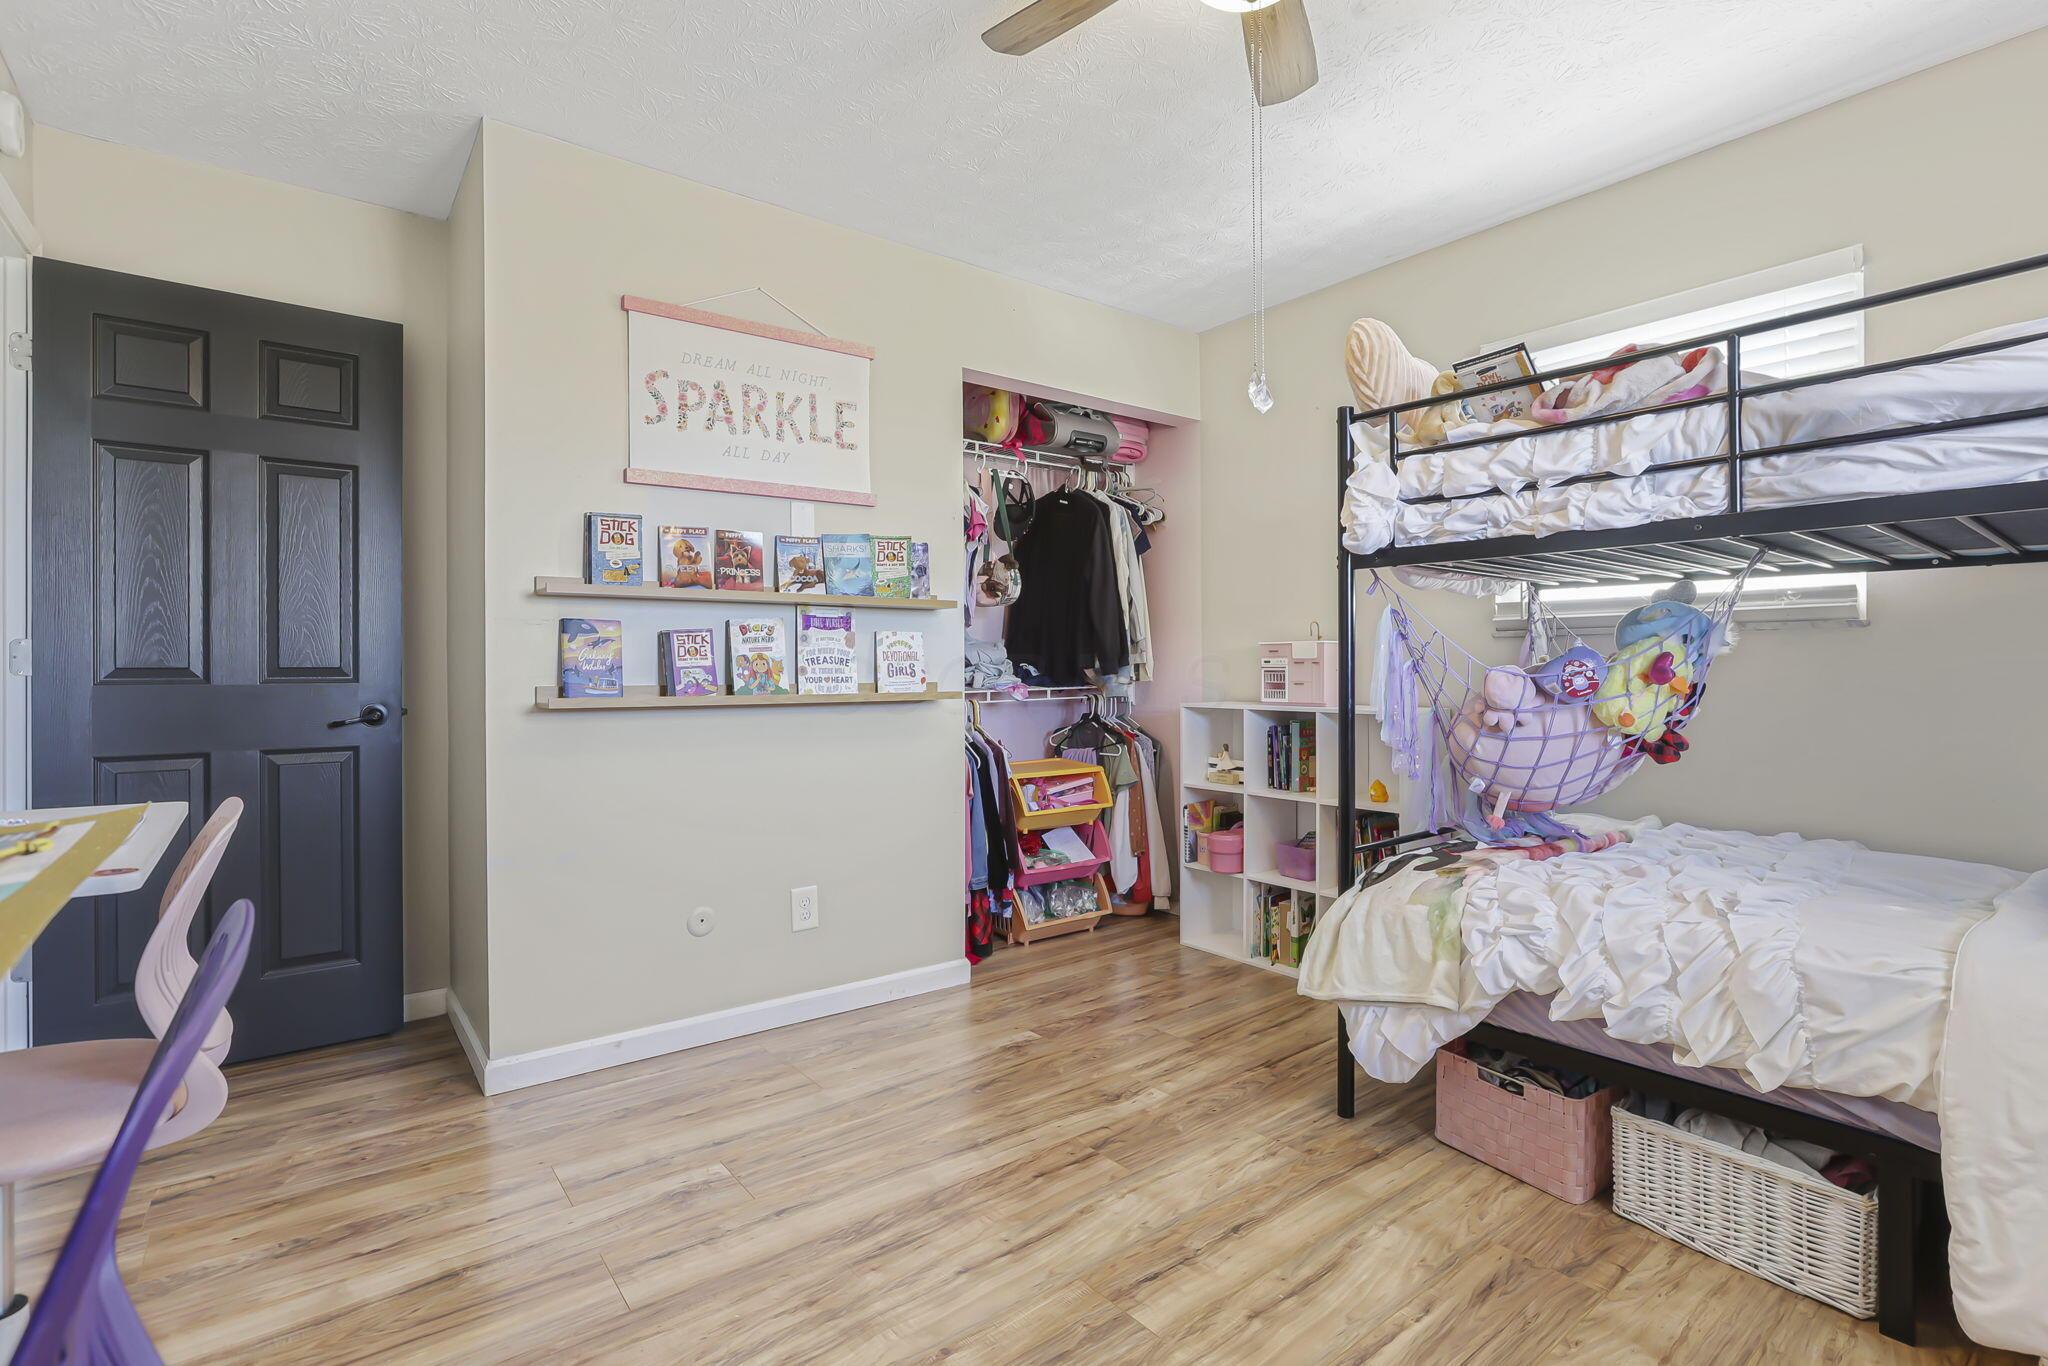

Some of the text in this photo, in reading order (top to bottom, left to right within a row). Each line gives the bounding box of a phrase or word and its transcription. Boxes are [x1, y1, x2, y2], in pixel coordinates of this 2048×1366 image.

[680, 352, 832, 391] DREAM ALL NIGHT,
[644, 369, 858, 451] SPARKLE
[722, 445, 791, 465] ALL DAY
[600, 518, 638, 533] STICK
[599, 530, 635, 546] DOG
[877, 541, 906, 551] STICK
[876, 550, 905, 563] DOG
[719, 566, 761, 577] PRINCESS
[676, 634, 710, 645] STICK
[677, 645, 709, 658] DOG
[804, 655, 850, 668] TREASURE
[887, 662, 916, 678] GIRLS
[804, 676, 853, 684] YOUR HEART
